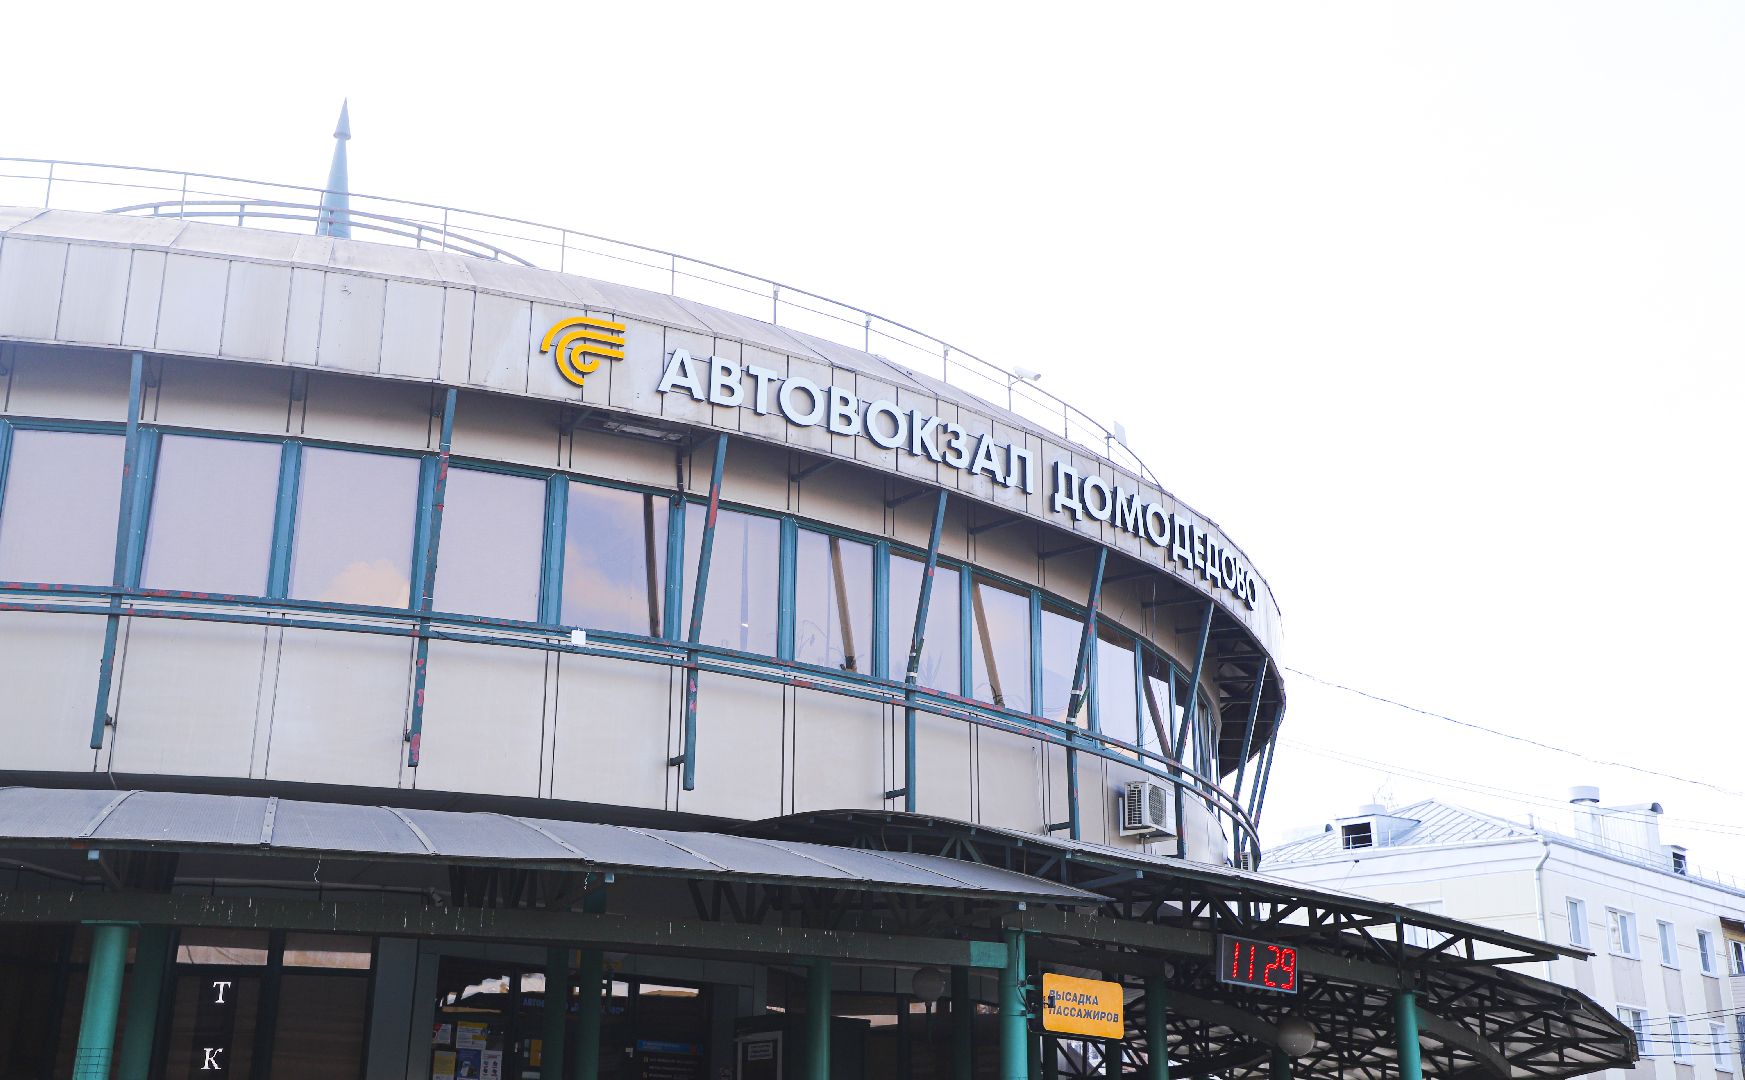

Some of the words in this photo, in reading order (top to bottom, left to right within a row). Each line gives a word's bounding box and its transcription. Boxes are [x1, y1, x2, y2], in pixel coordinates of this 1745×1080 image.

[657, 348, 1034, 495] АВТОВОКЗАЛ
[1051, 459, 1258, 611] ДОМОДЕДОВО
[1049, 989, 1099, 1006] ВЫСАДКА
[1048, 1005, 1119, 1023] ПАССАЖИРОВ
